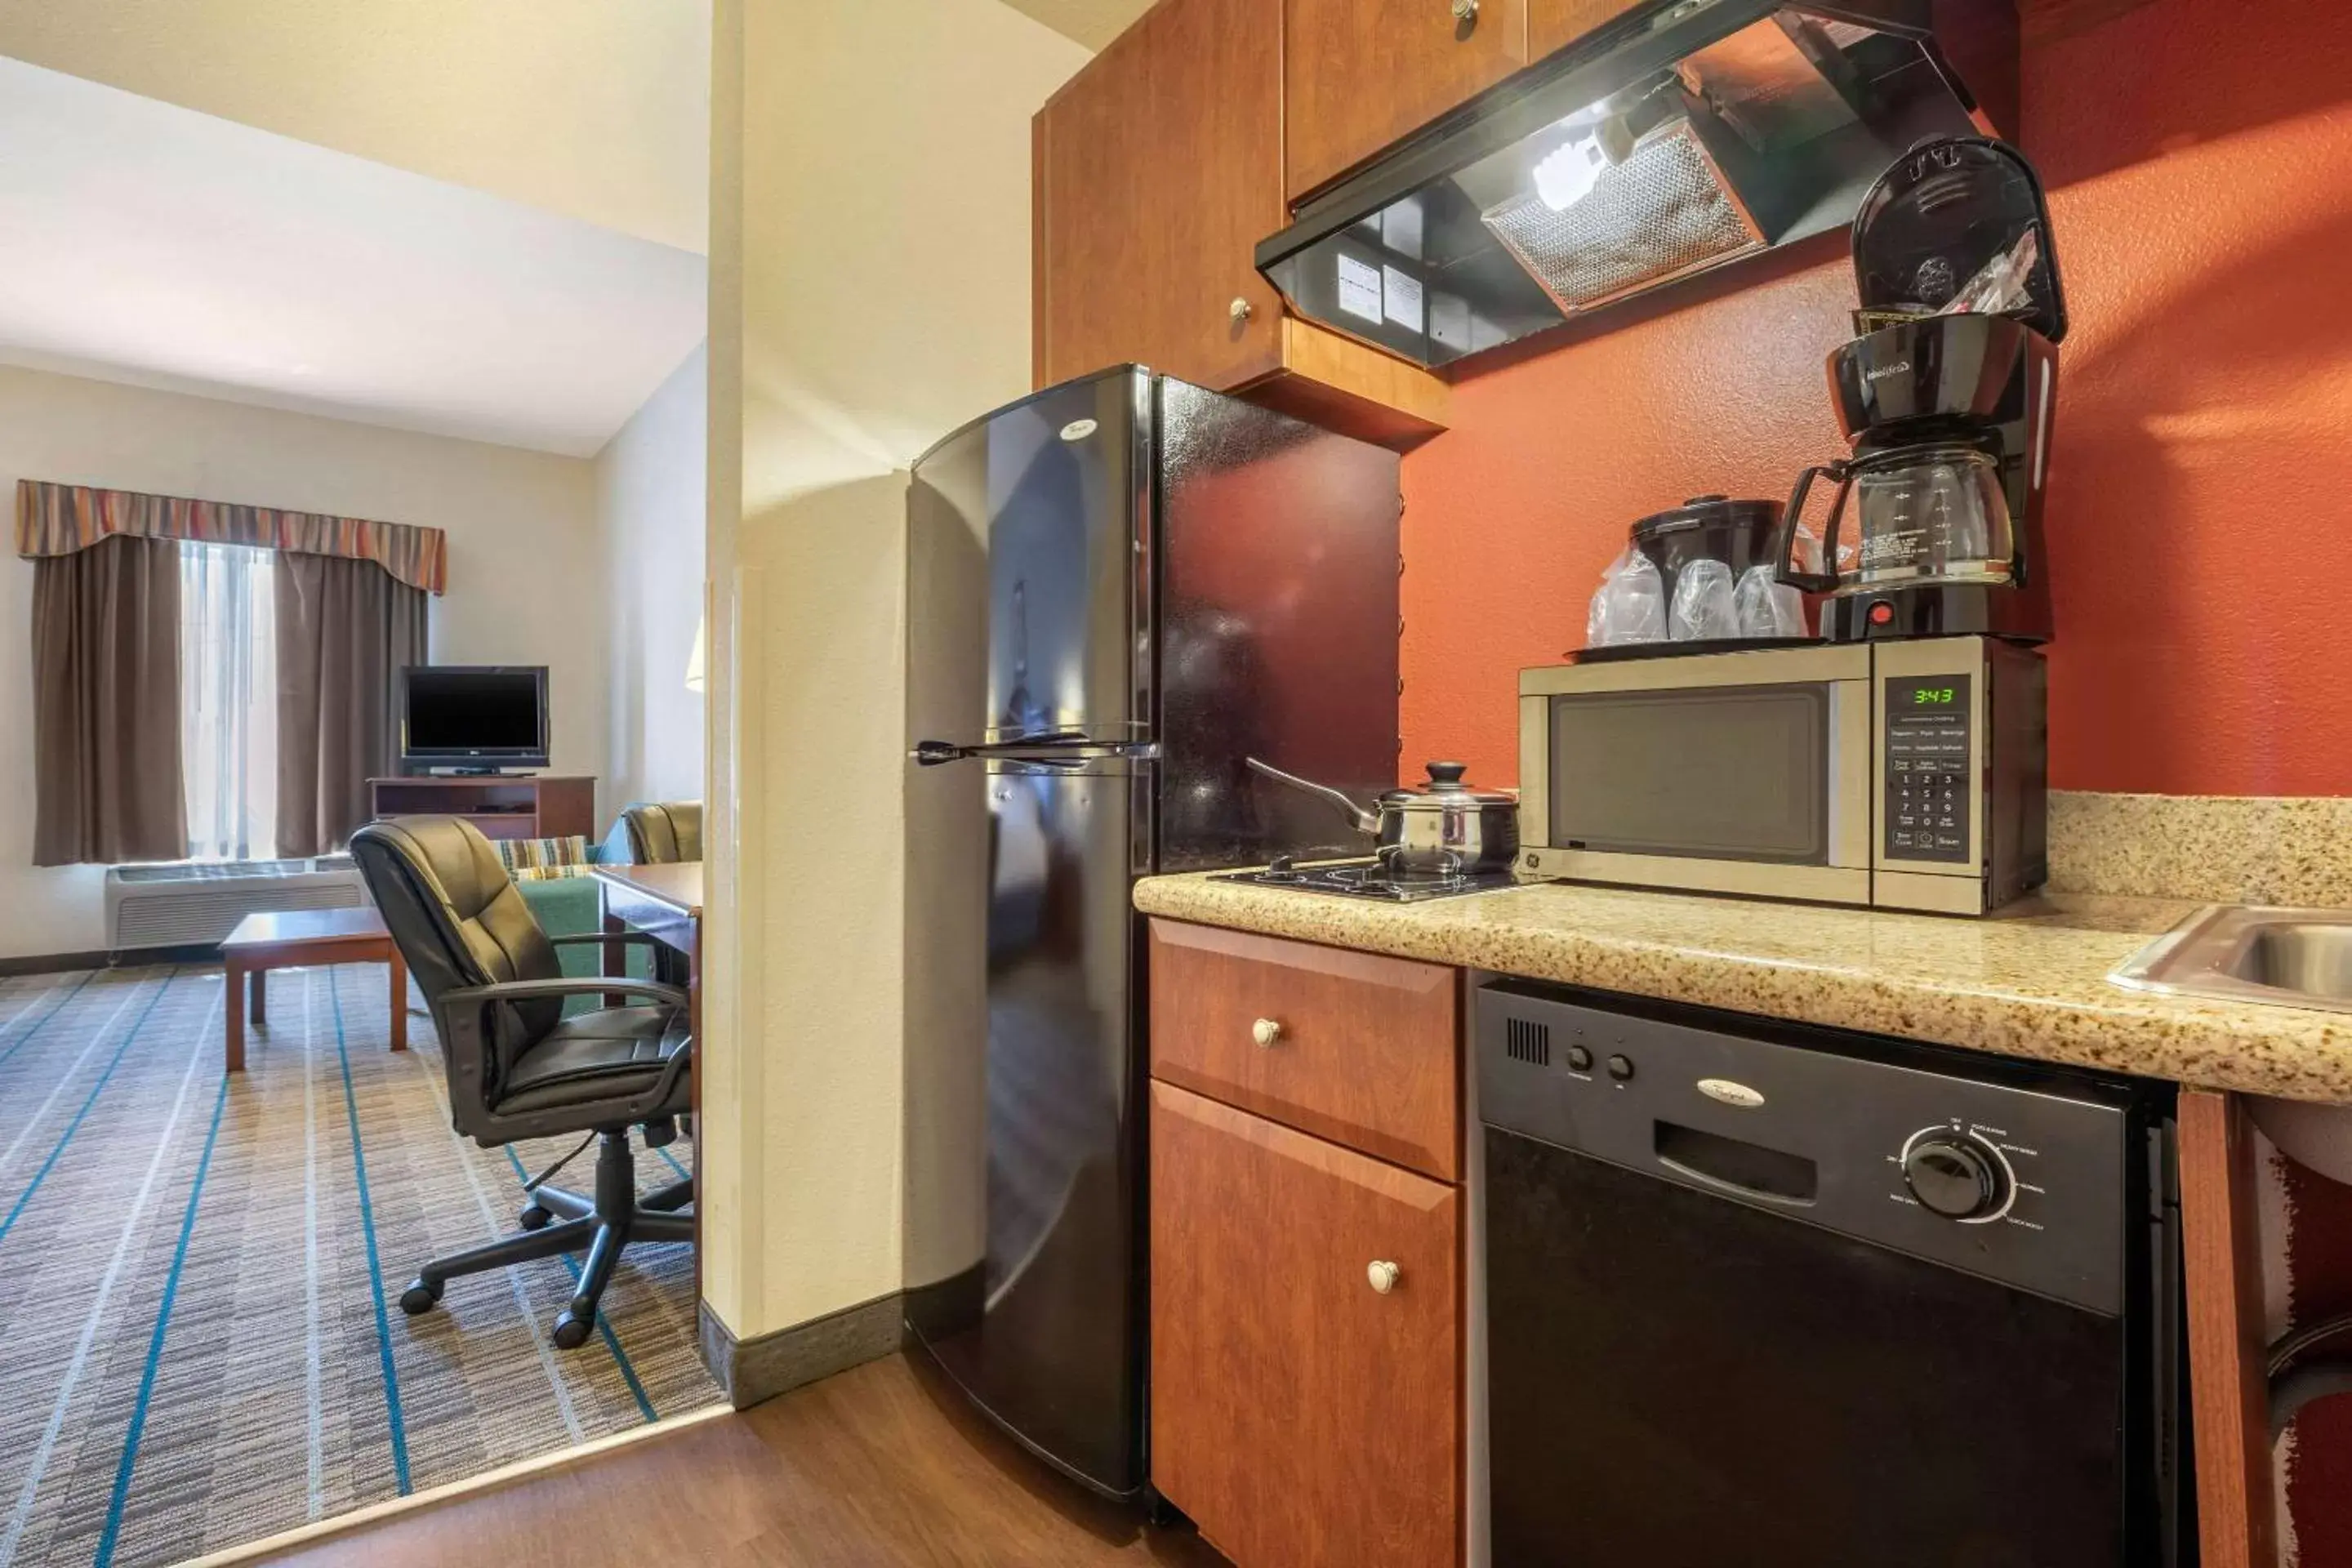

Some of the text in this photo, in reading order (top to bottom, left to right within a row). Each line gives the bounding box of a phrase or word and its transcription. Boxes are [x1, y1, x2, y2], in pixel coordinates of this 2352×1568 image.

[1914, 689, 1953, 703] 3:43
[1904, 775, 1909, 784] 1
[1923, 775, 1931, 784] 2
[1944, 775, 1952, 784] 3
[1902, 789, 1909, 798] 4
[1923, 789, 1931, 798] 5
[1944, 790, 1952, 799] 6
[1903, 803, 1909, 812] 7
[1923, 804, 1930, 812] 8
[1944, 804, 1951, 813] 9
[1923, 817, 1931, 826] 0
